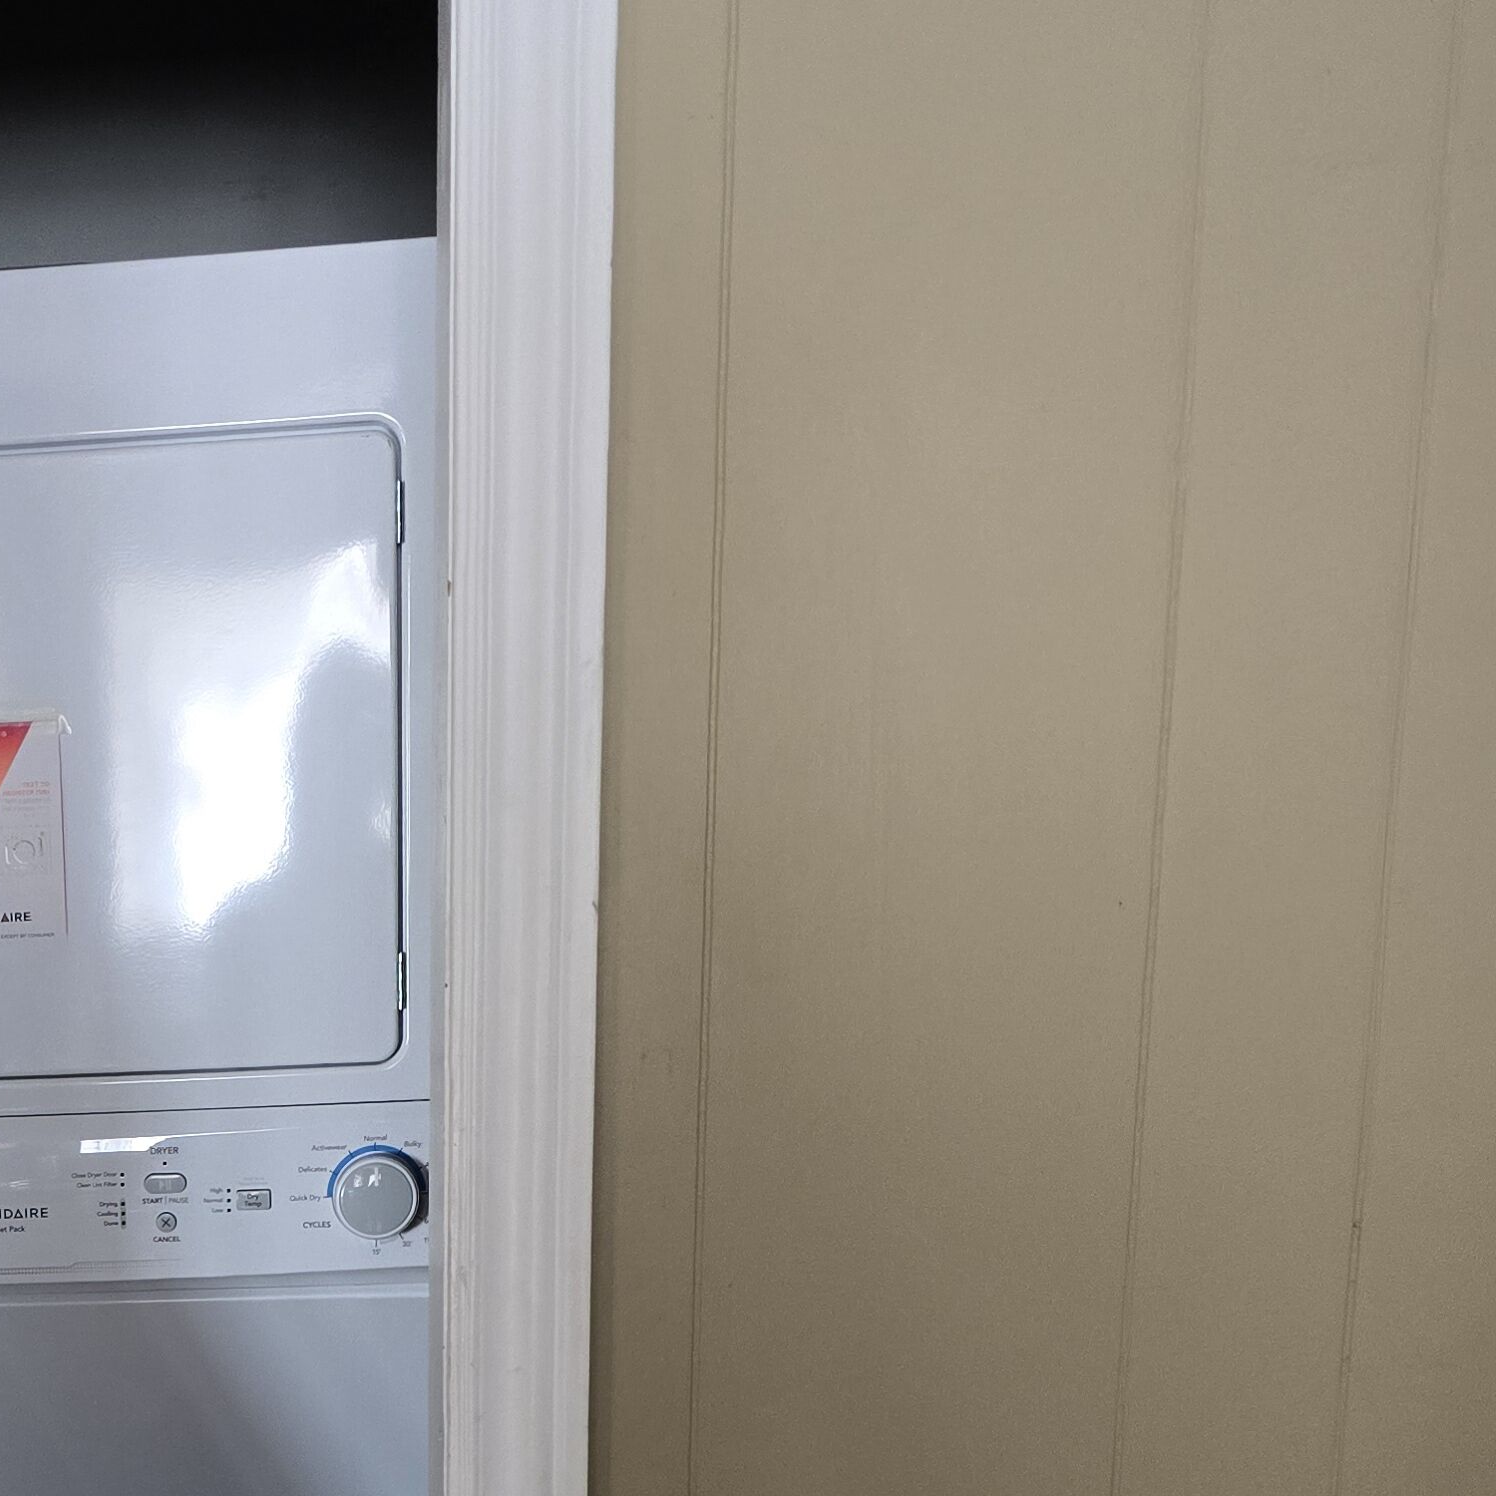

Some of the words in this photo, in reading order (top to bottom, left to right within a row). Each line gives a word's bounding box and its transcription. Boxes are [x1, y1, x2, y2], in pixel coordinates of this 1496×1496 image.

[363, 1134, 388, 1142] Normal
[404, 1140, 422, 1148] Bulky
[150, 1146, 179, 1155] DRYER
[247, 1193, 259, 1201] Dry
[309, 1194, 321, 1202] Dry
[244, 1199, 262, 1208] Temp
[302, 1221, 332, 1229] CYCLES
[153, 1235, 181, 1243] CANCEL
